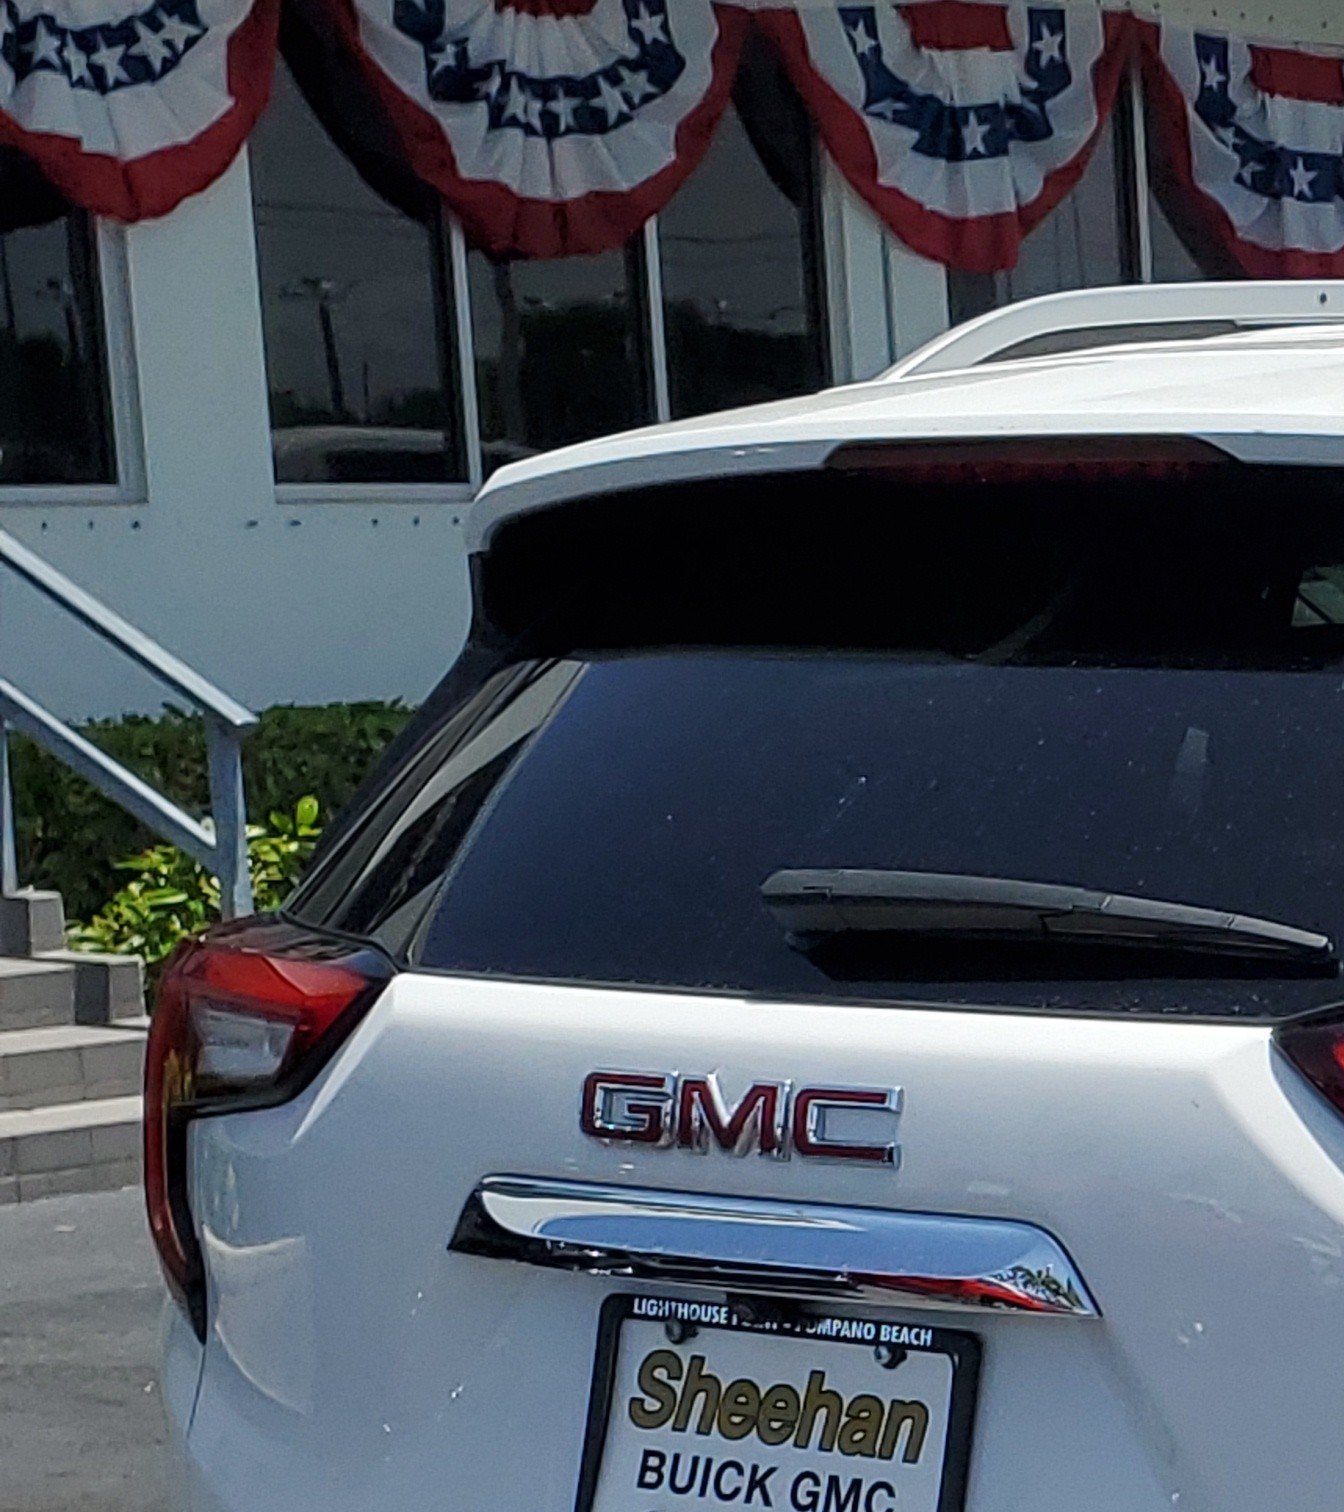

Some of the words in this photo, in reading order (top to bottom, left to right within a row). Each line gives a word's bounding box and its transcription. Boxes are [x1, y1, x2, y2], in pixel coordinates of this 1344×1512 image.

[579, 1069, 904, 1169] GMC
[633, 1297, 728, 1325] LIGHTHOUSE
[793, 1316, 876, 1341] OMPANO
[879, 1321, 933, 1347] BEACH
[628, 1348, 930, 1464] Sheehan
[637, 1448, 779, 1508] BUICK
